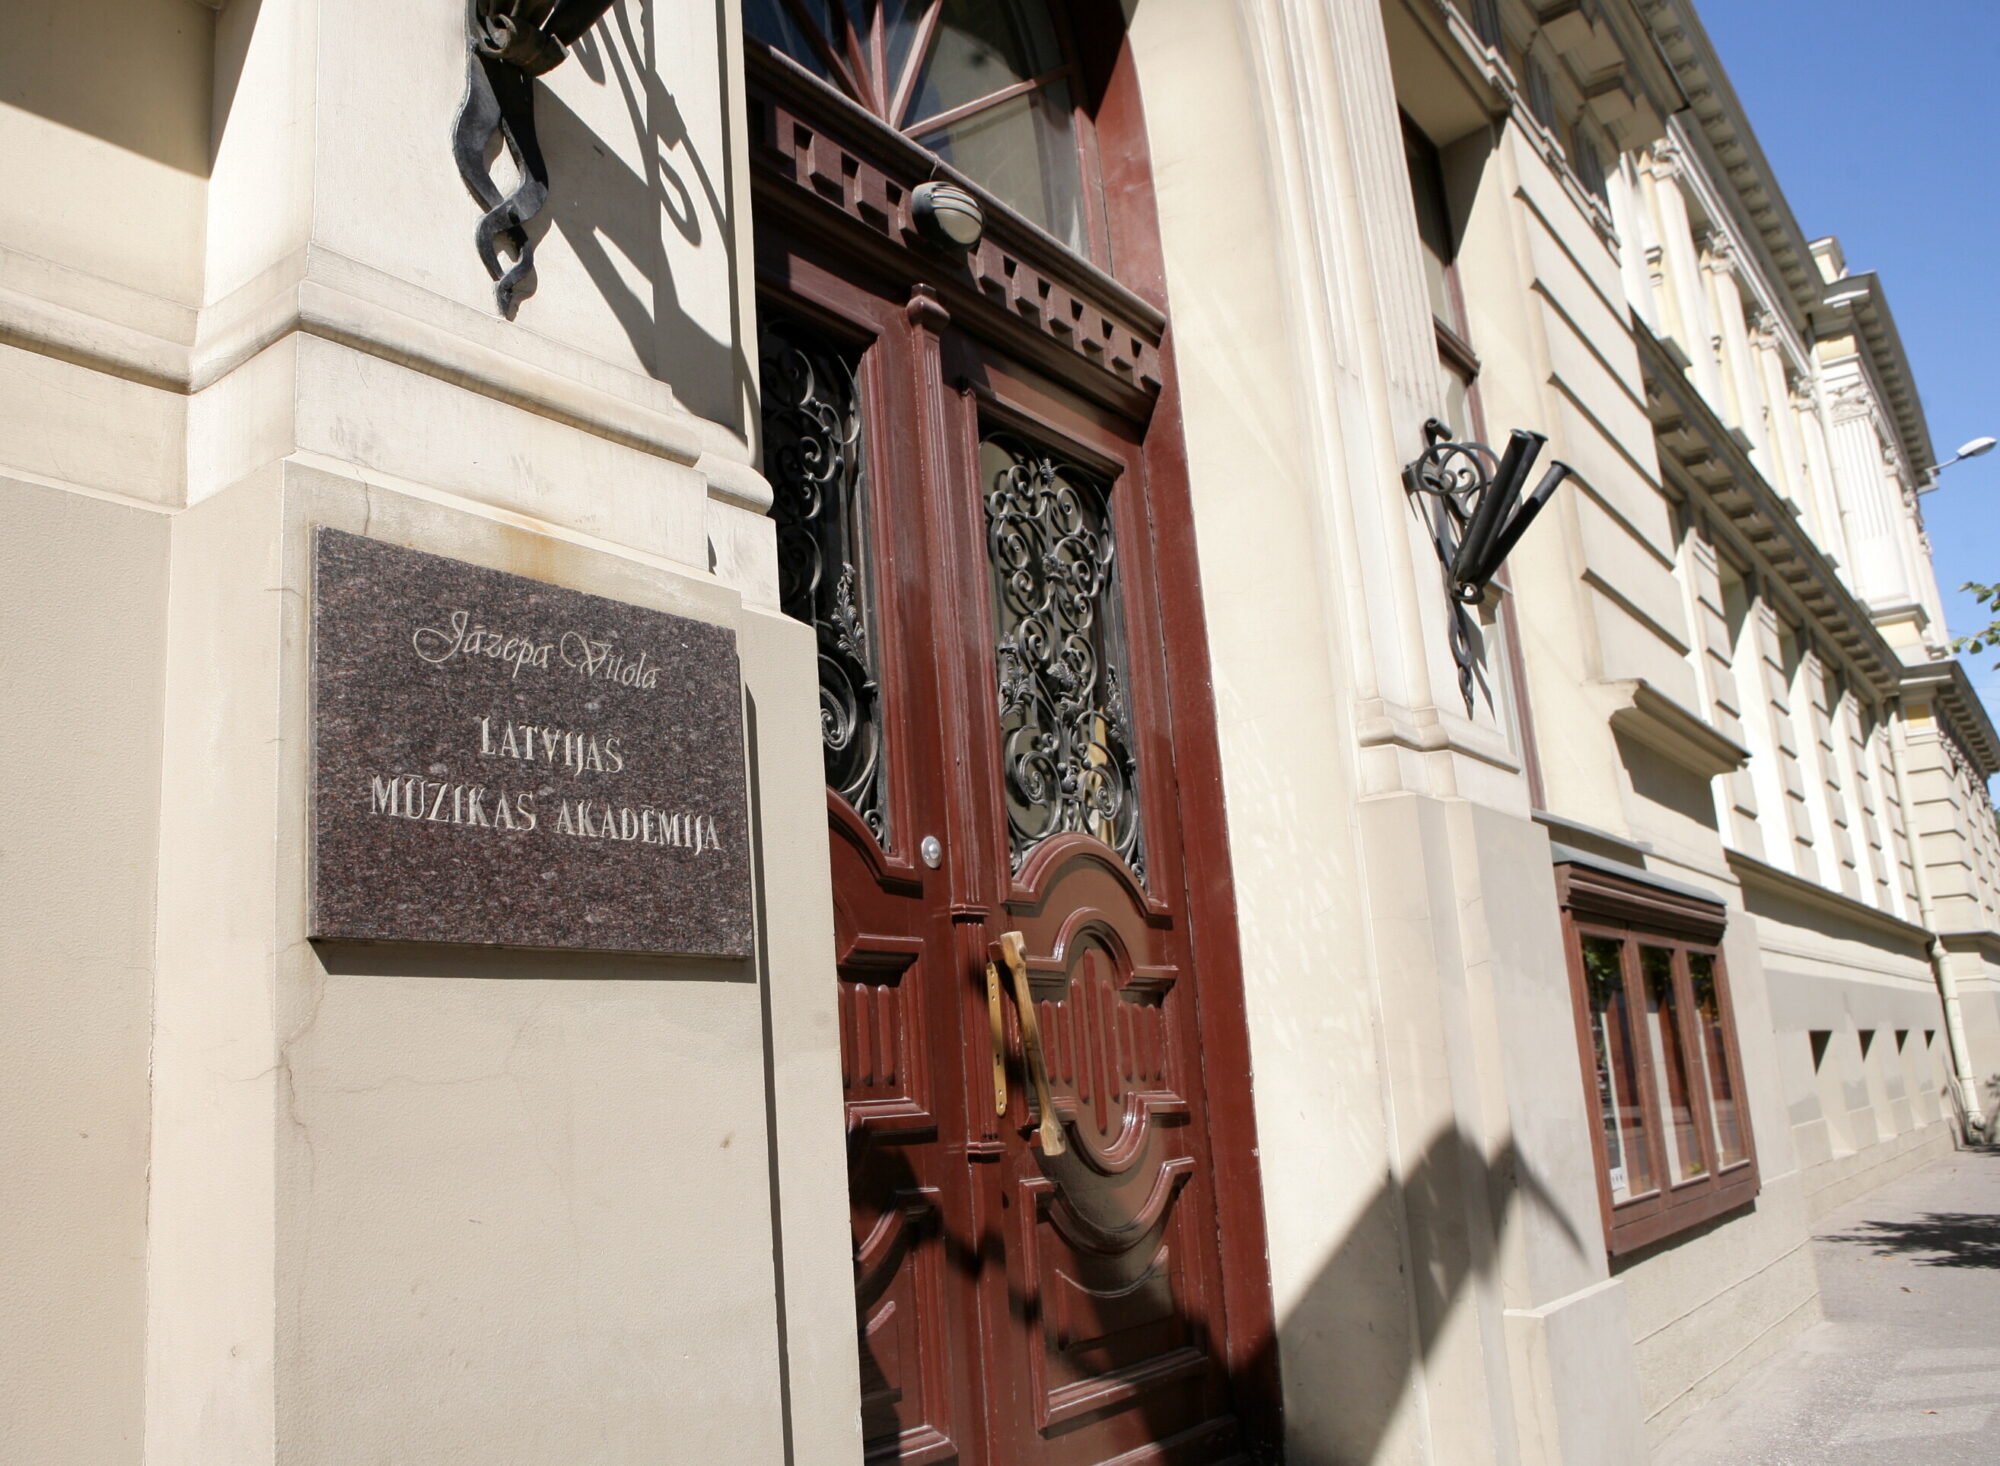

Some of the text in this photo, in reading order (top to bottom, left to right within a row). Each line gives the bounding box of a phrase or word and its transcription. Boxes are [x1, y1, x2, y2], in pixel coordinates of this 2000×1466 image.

[413, 610, 554, 678] Jāzepa
[480, 715, 624, 776] LATVIJAS
[369, 773, 722, 855] MŪZIKAS AKADĒMIJA
